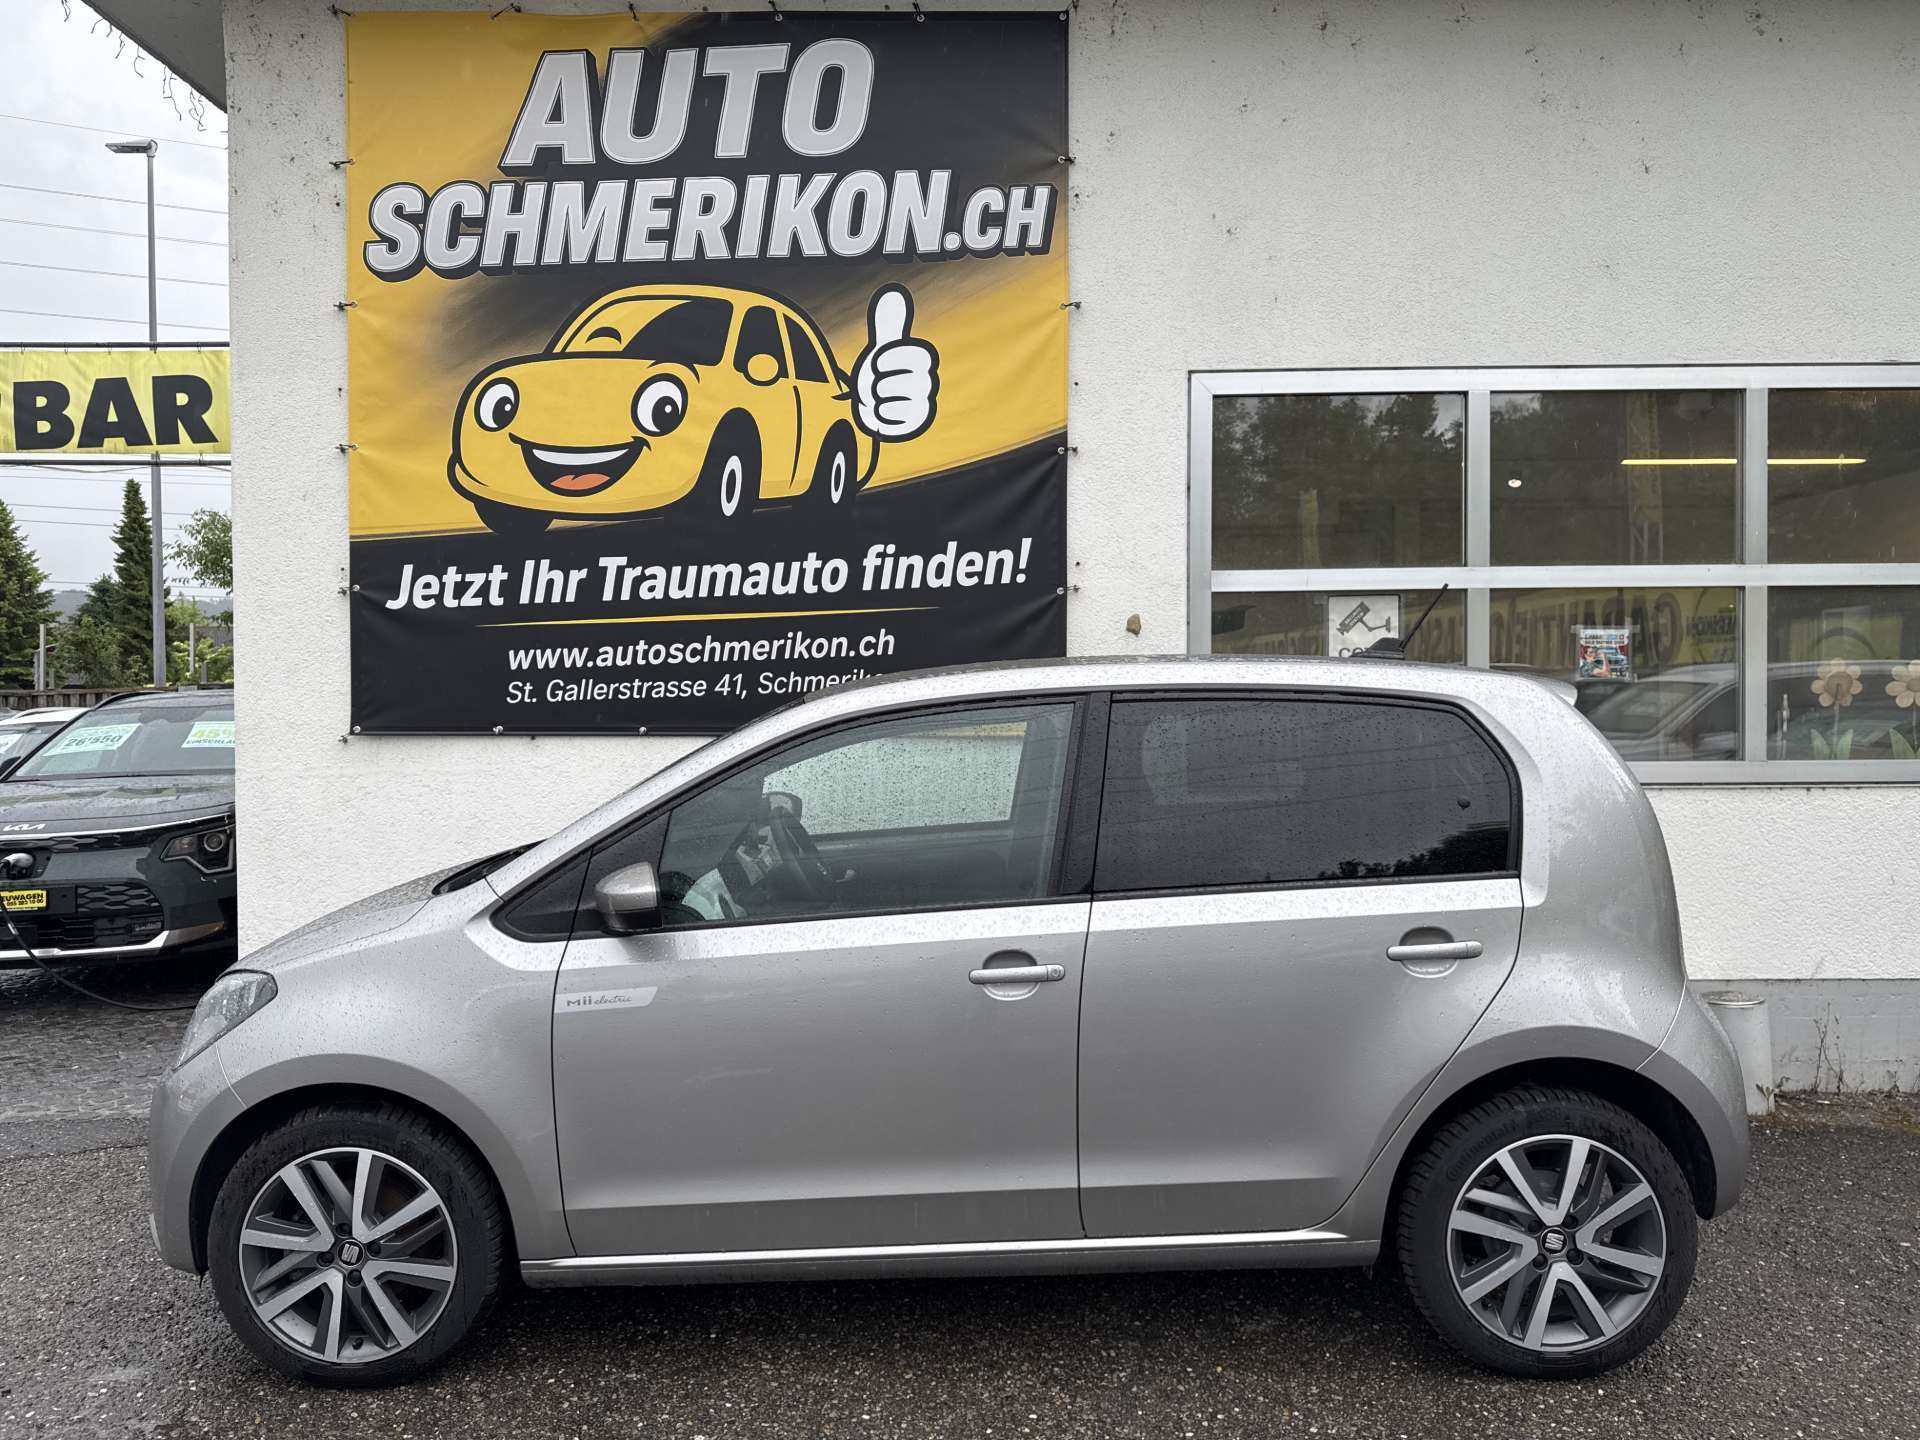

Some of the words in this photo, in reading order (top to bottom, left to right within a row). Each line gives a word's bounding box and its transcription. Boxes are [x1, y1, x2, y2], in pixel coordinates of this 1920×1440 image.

[502, 38, 875, 168] AUTO
[365, 169, 1054, 275] SCHMERIKON.CH
[0, 374, 219, 451] BAR
[385, 563, 509, 610] Jetzt
[519, 558, 588, 604] Ihr
[598, 552, 849, 602] Traumauto
[862, 537, 1032, 591] finden!
[506, 681, 537, 703] St.
[546, 676, 708, 702] Gallerstrasse
[714, 673, 747, 700] 41,
[757, 669, 883, 695] Schmerik
[507, 629, 895, 671] www.autoschmerikon.ch
